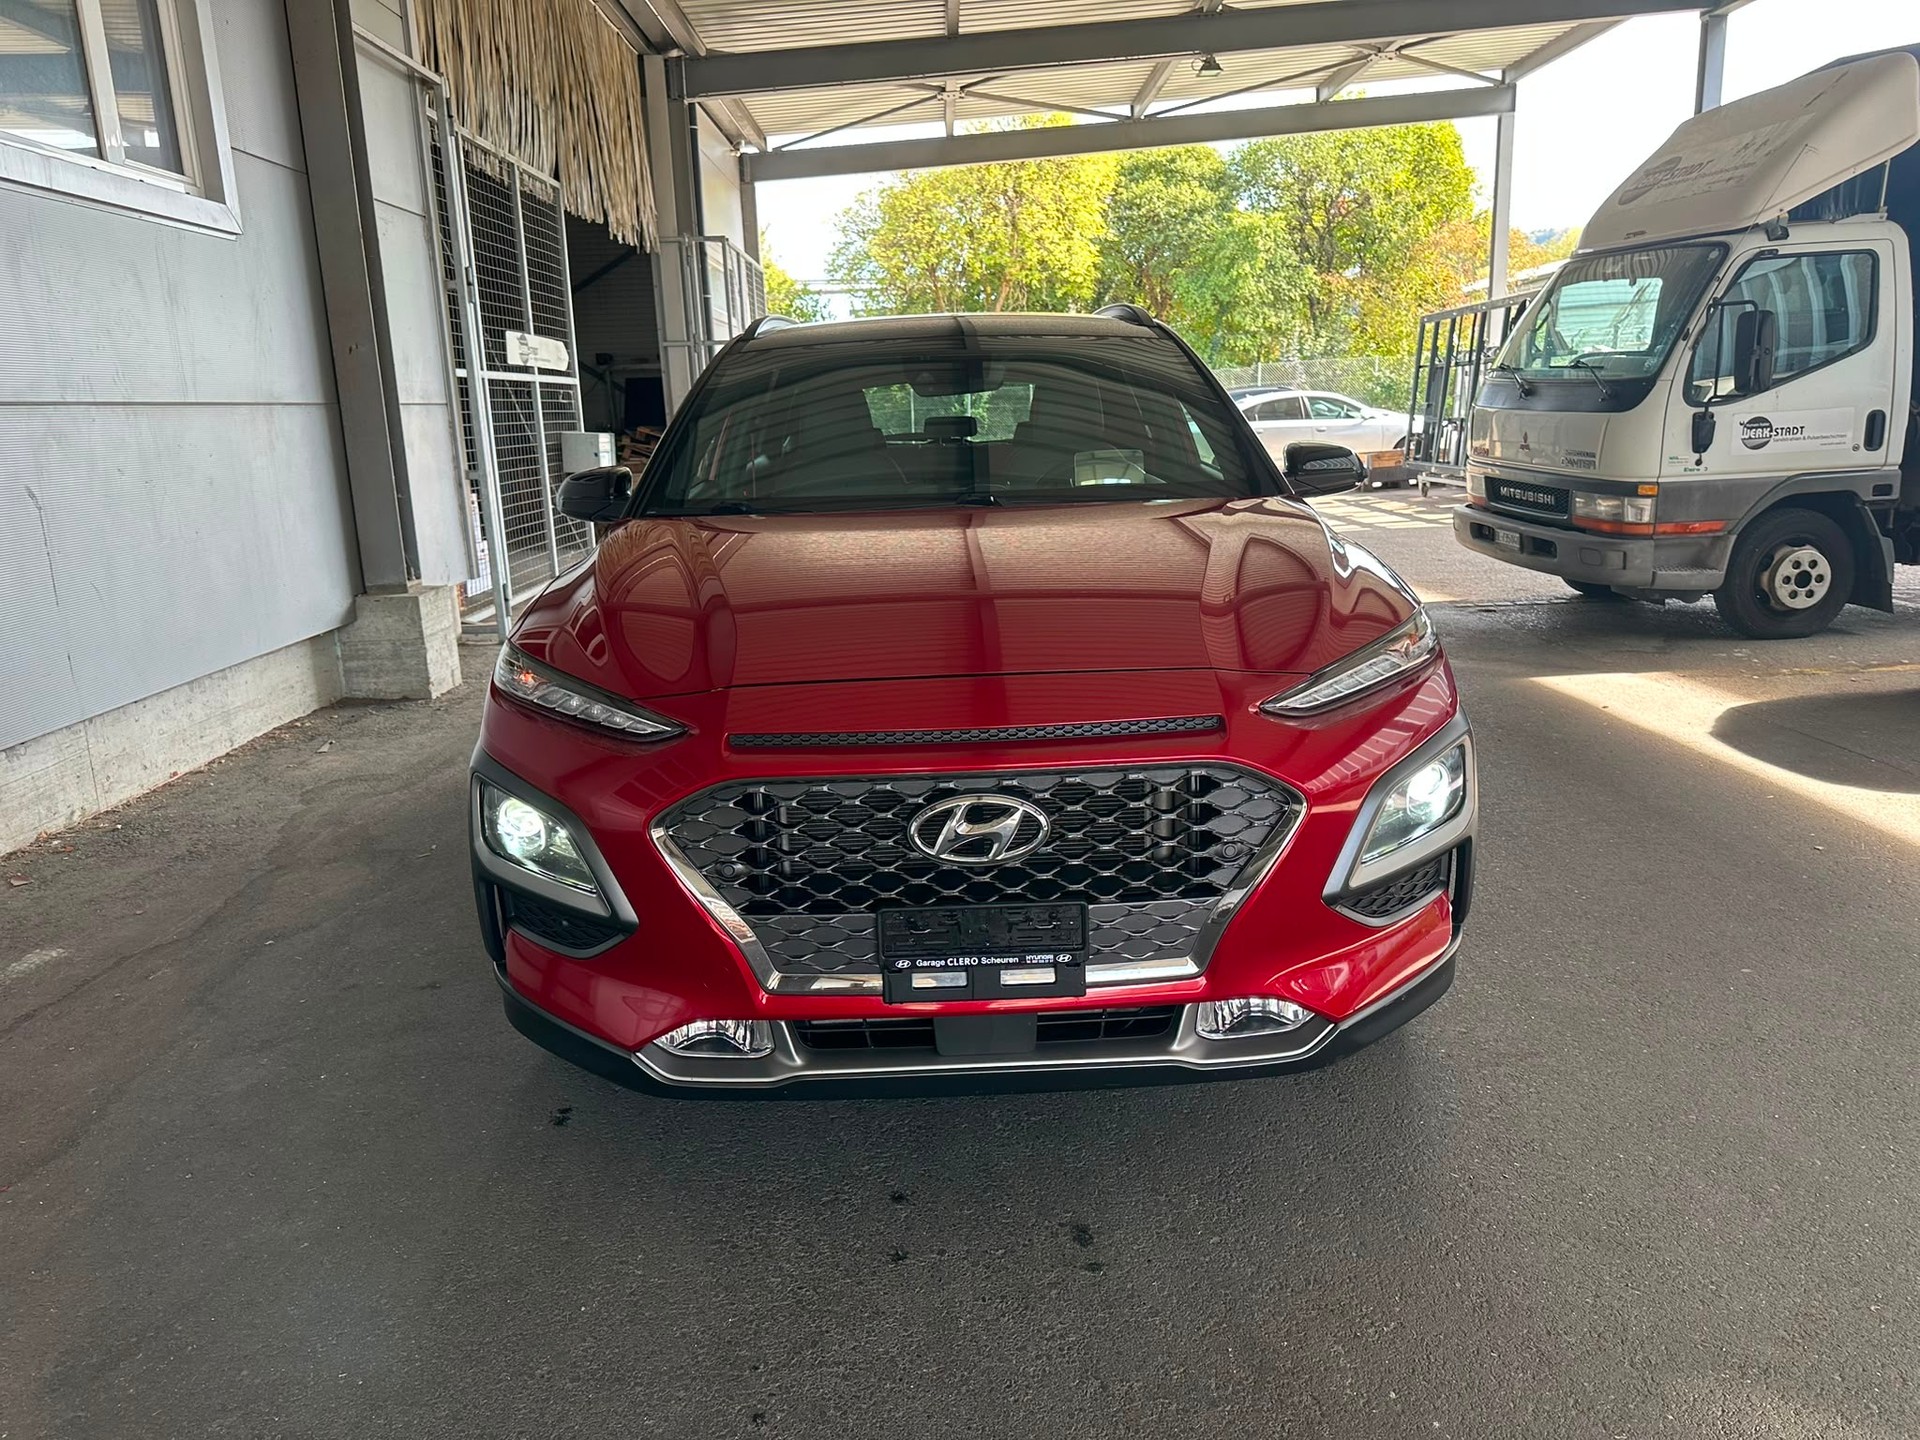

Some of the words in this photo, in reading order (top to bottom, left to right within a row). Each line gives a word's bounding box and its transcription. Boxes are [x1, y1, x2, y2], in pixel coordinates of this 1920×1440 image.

[1500, 486, 1555, 505] MITSUBISHI
[916, 959, 945, 967] Garage
[947, 957, 978, 966] CLERO
[980, 957, 1018, 965] Scheuren
